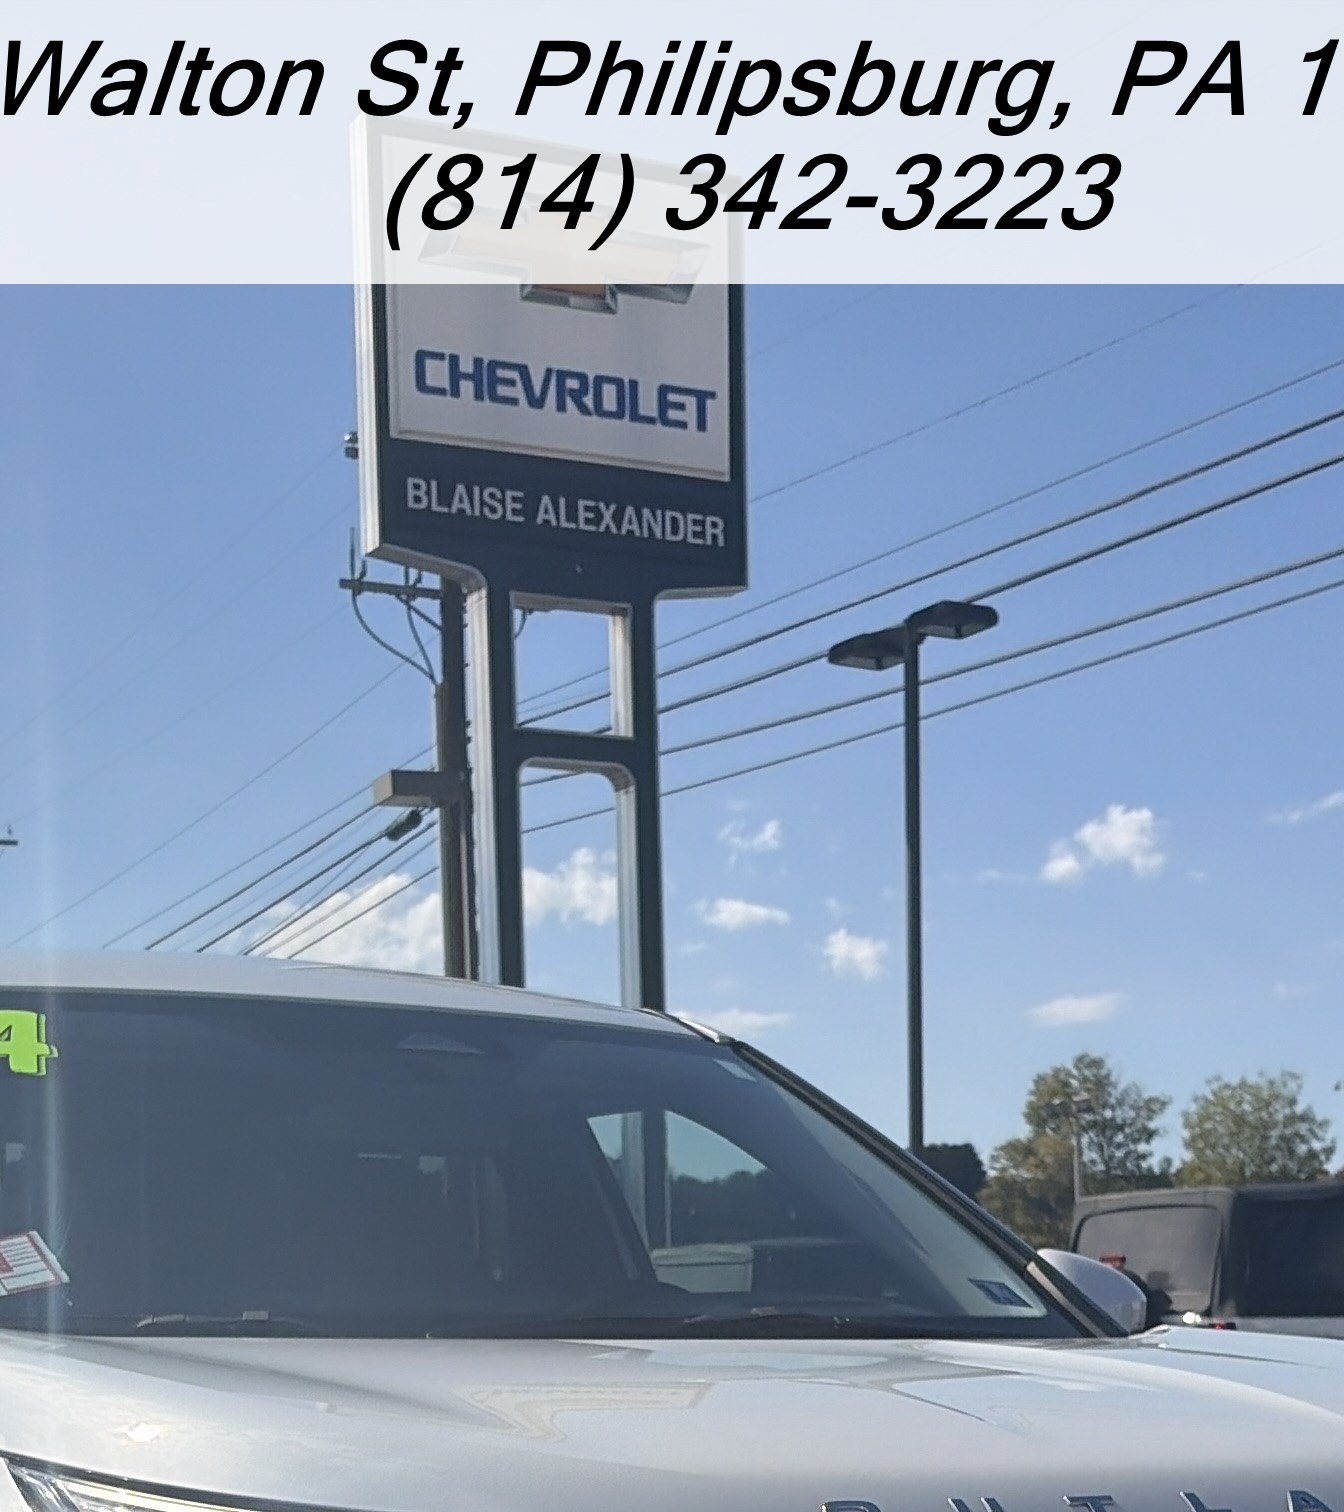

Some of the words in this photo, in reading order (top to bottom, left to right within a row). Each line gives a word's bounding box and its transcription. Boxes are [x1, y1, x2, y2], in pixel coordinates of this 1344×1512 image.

[414, 348, 717, 433] CHEVROLET
[406, 477, 525, 524] BLAISE
[535, 494, 726, 548] ALEXANDER
